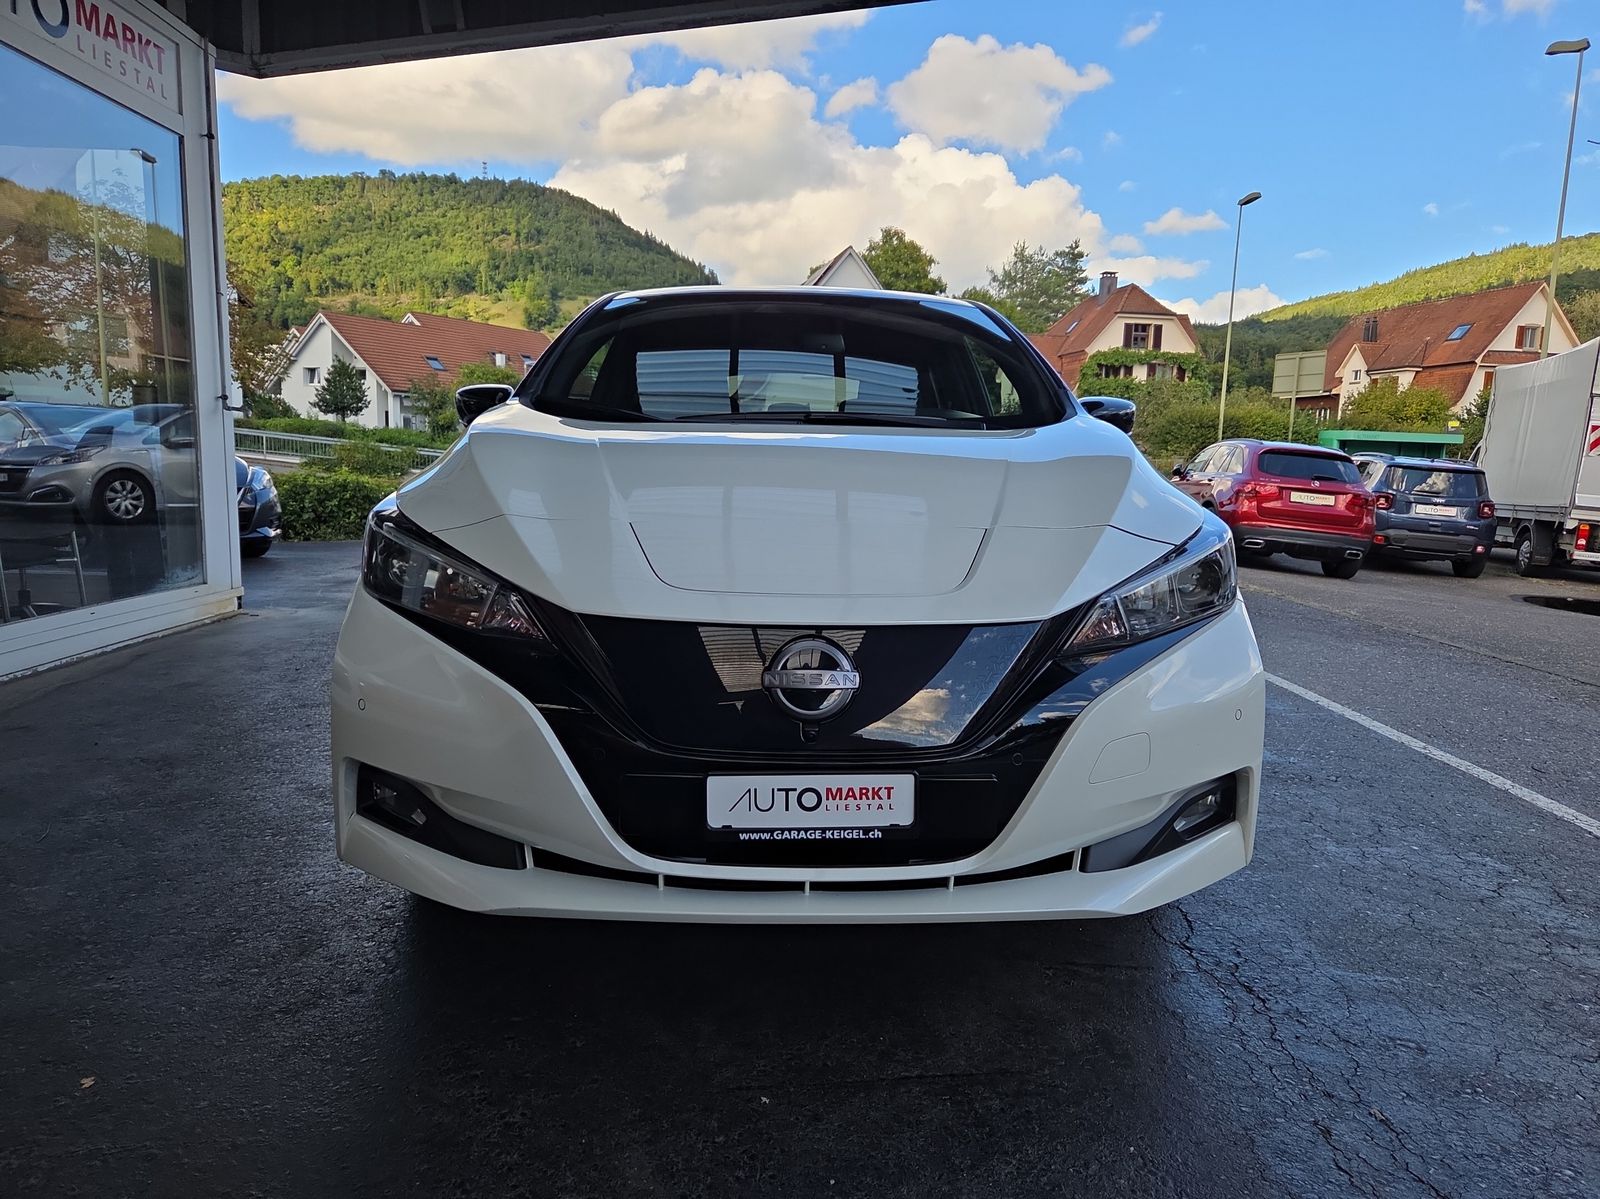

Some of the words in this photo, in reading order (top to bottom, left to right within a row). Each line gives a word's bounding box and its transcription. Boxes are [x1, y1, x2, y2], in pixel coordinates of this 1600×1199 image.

[76, 0, 165, 74] MARKT
[77, 34, 167, 100] LIESTAL
[764, 673, 857, 687] NISSAN
[728, 787, 823, 812] AUTO
[825, 786, 895, 801] MARKT
[825, 803, 895, 812] LIESTAL
[739, 829, 882, 841] www.GARAGE-KEIGEL.ch
